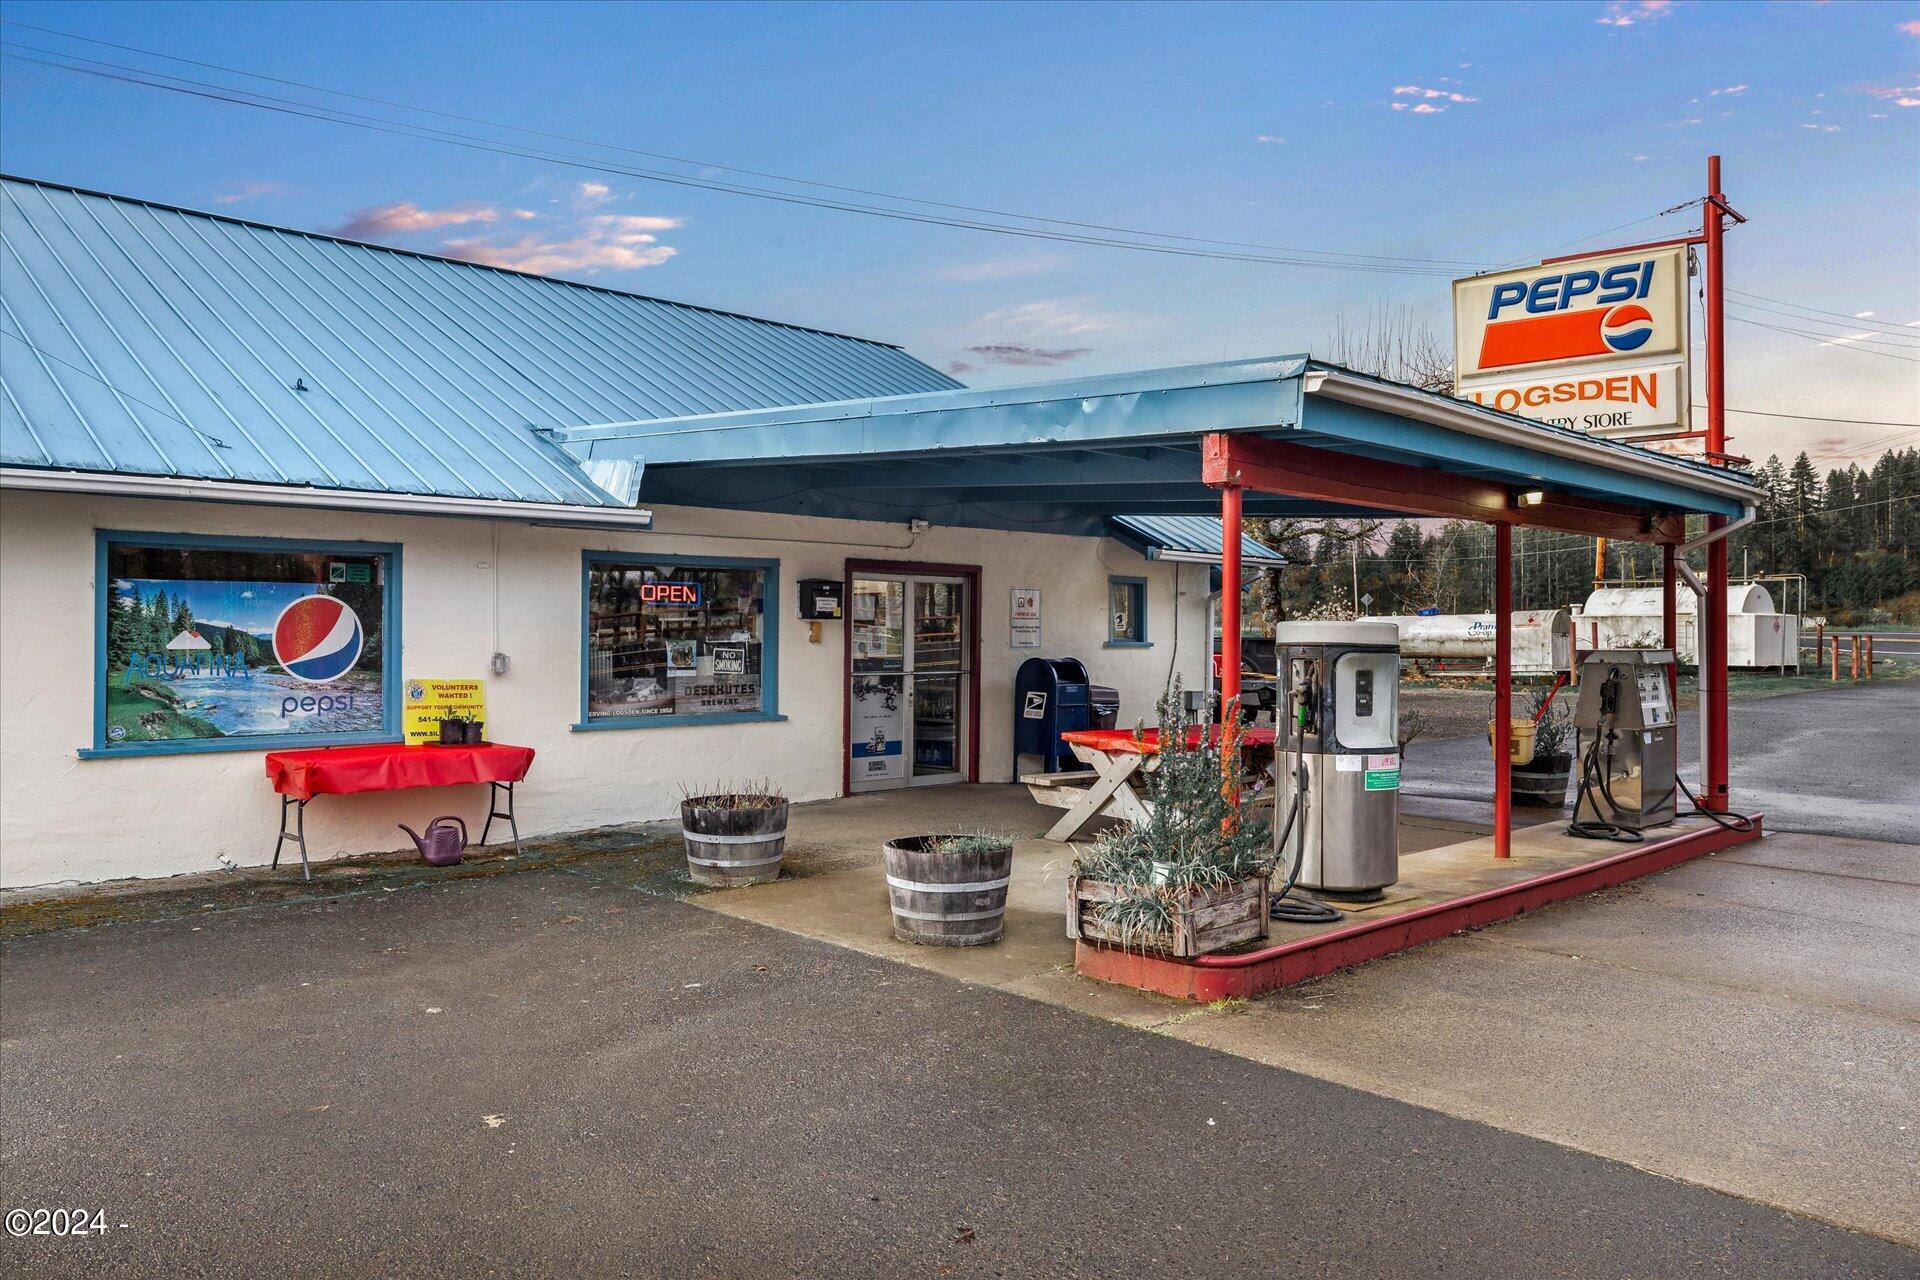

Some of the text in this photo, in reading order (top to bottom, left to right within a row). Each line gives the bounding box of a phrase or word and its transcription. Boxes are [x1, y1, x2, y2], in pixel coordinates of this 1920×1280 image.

[1488, 260, 1656, 320] PEPSI
[1584, 411, 1633, 430] STORE
[641, 585, 696, 602] OPEN
[722, 651, 736, 659] NO
[125, 650, 250, 685] AQUAFINA
[714, 659, 742, 671] SMOKING
[684, 683, 755, 696] DESCHUTES
[281, 691, 354, 718] pepsi
